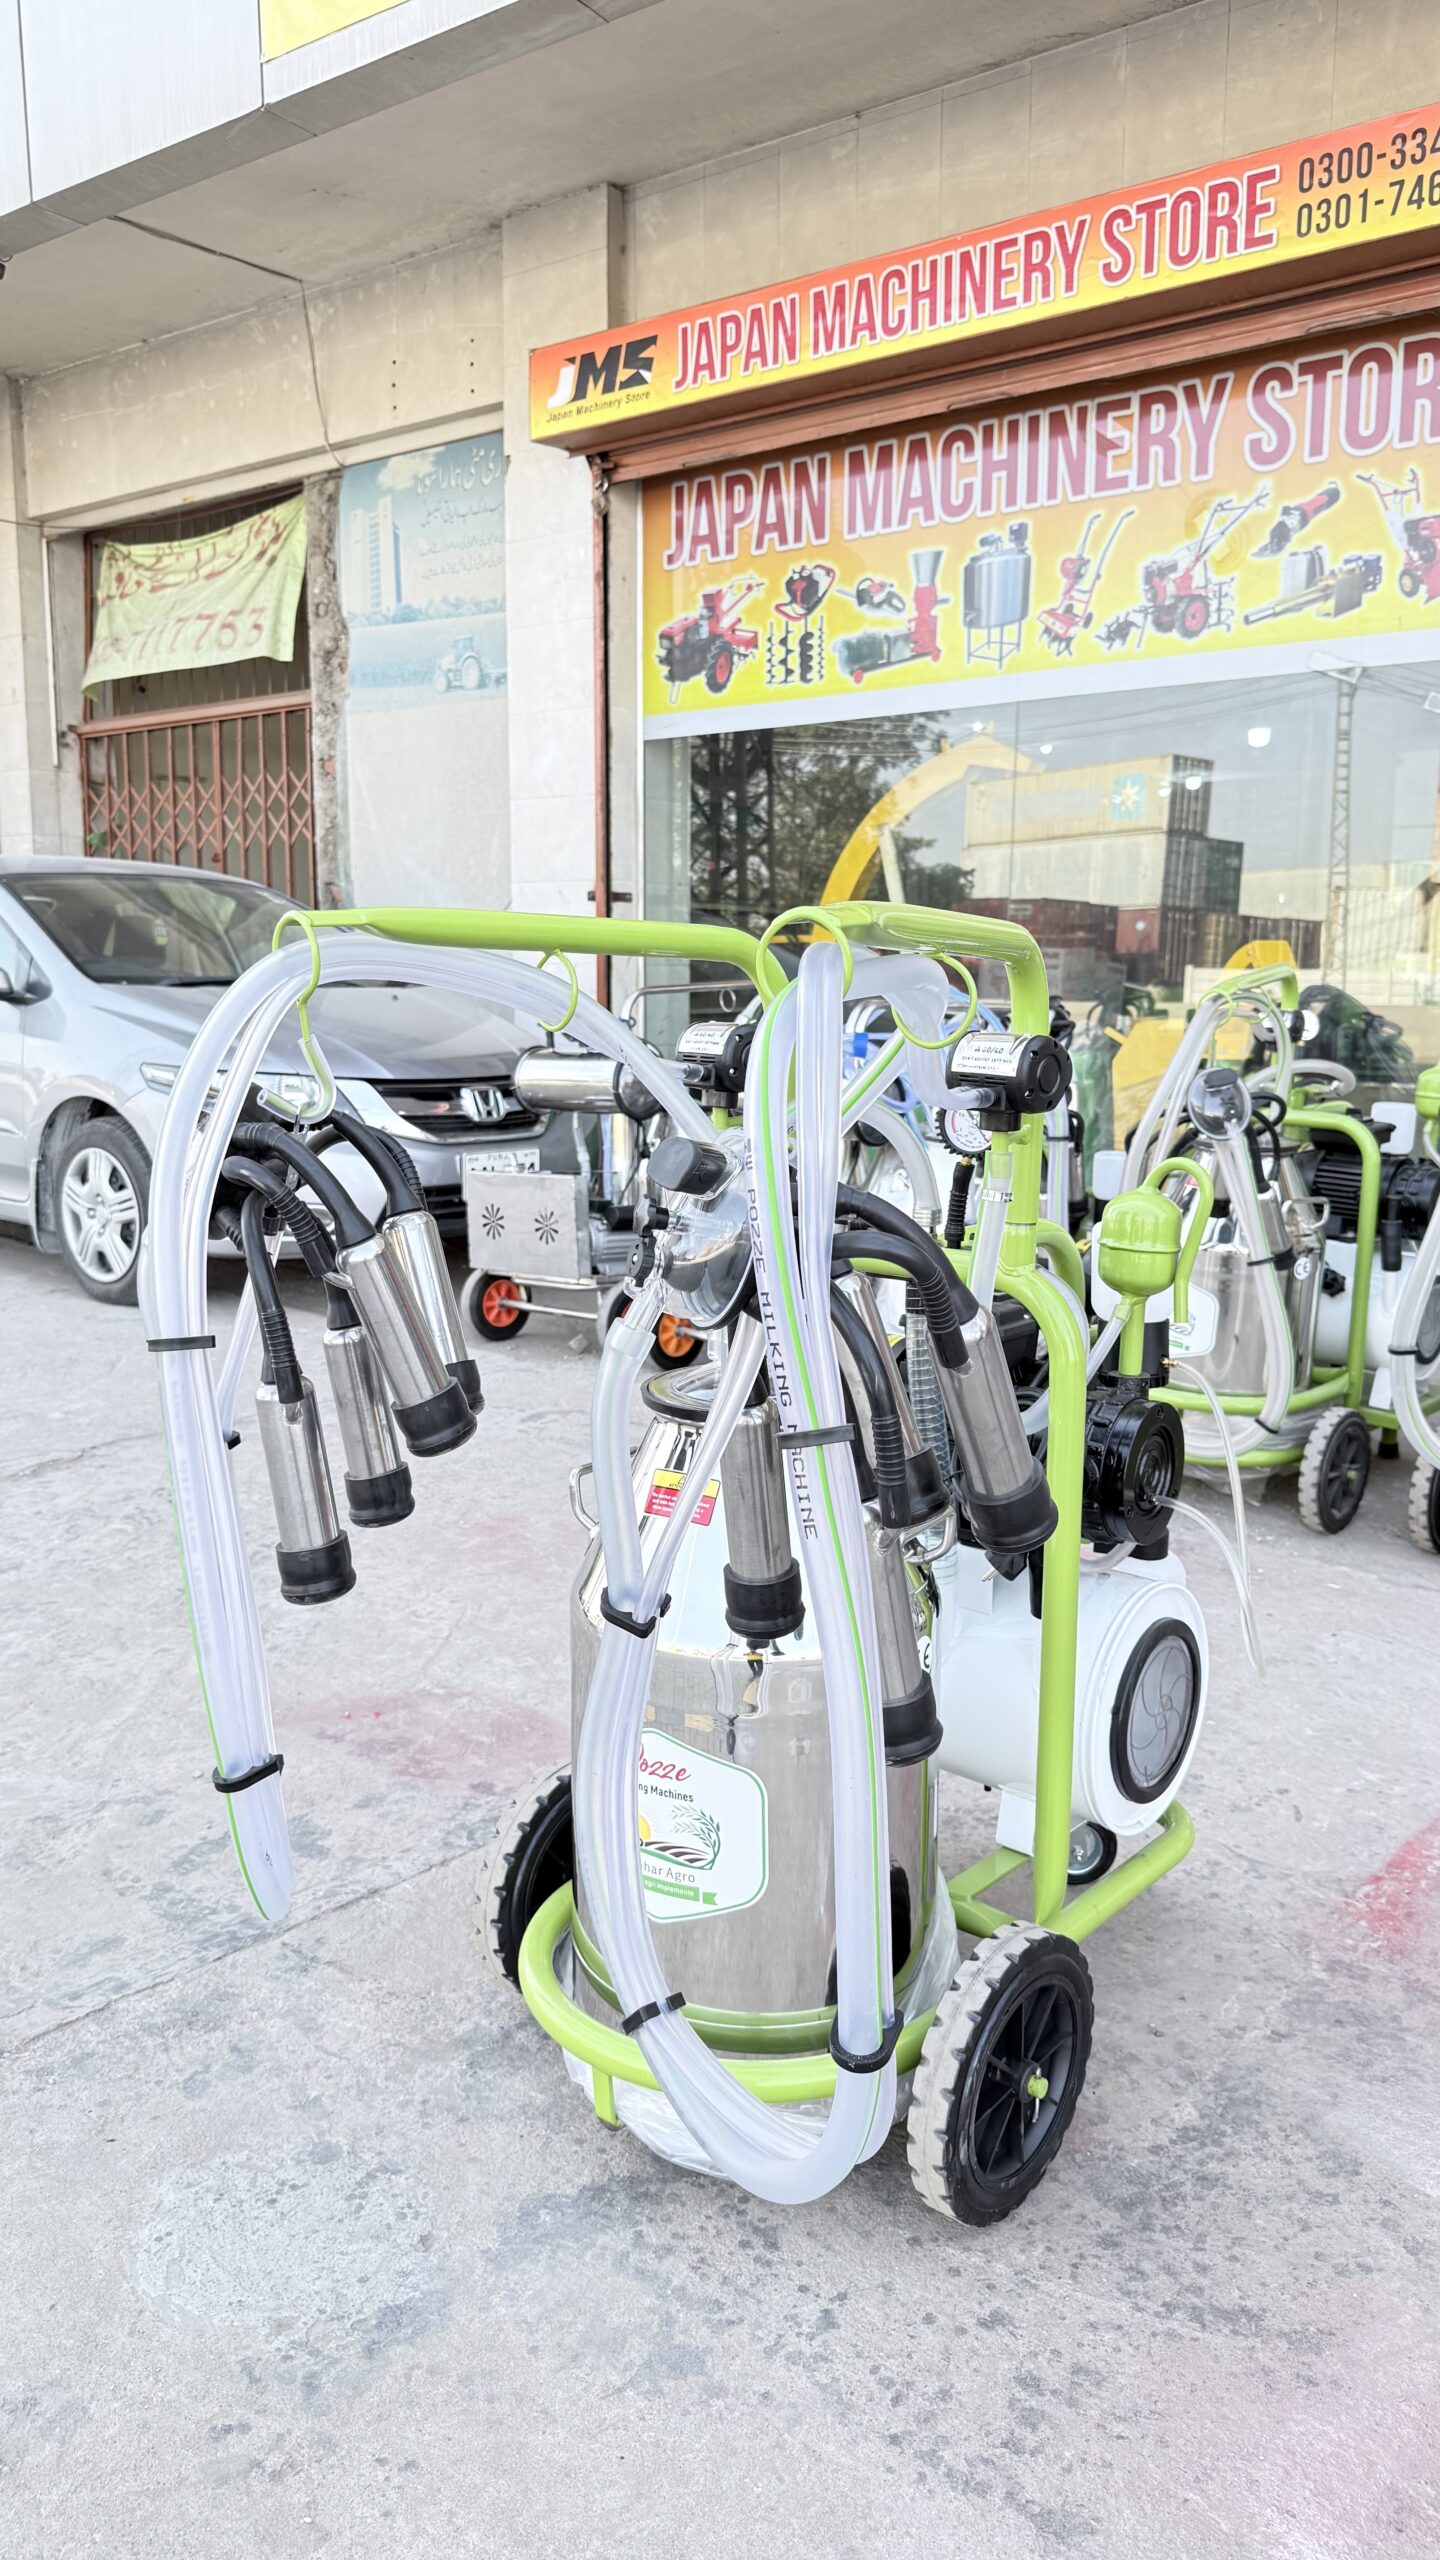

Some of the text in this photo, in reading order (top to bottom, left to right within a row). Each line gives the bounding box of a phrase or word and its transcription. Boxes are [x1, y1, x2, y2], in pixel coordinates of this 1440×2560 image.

[1296, 169, 1440, 239] 0301-746
[672, 164, 1280, 393] JAPAN MACHINERY STORE
[546, 334, 659, 409] JMS
[546, 391, 651, 424] Japan Machinery Store
[664, 331, 1440, 570] JAPAN MACHINERY STOR
[747, 1188, 766, 1275] POZZE
[760, 1291, 792, 1408] MILKING
[639, 1743, 692, 1782] ozze
[650, 1784, 694, 1803] Machines
[666, 1866, 696, 1883] Agro
